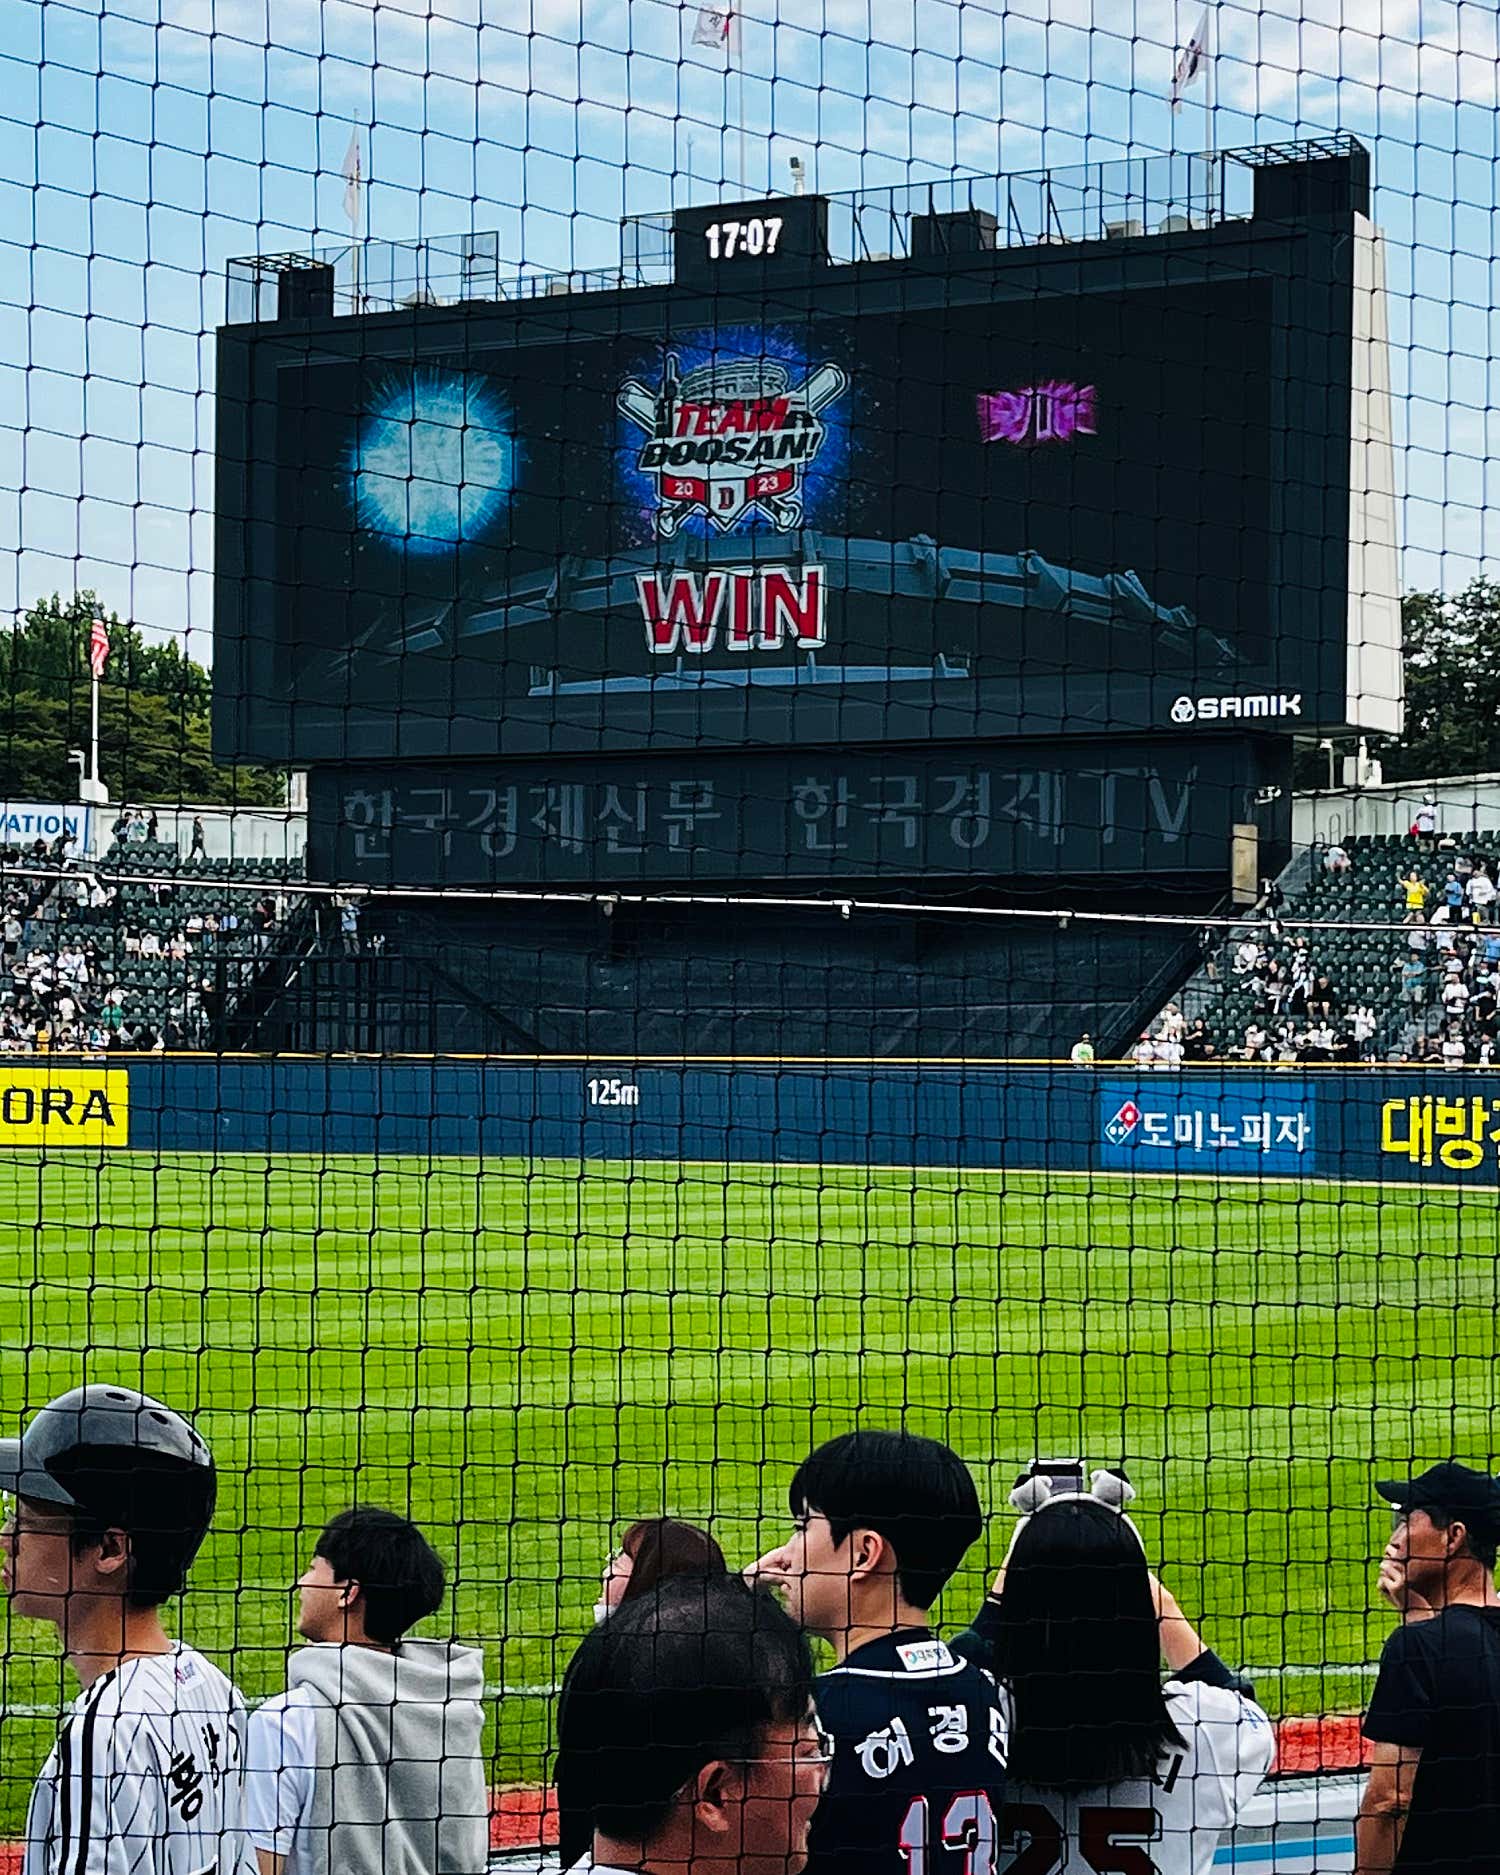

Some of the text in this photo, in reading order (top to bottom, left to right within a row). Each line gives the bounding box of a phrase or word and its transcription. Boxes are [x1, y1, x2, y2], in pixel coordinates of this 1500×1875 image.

[705, 218, 783, 259] 17:07
[675, 397, 790, 438] TEAM
[641, 431, 822, 468] DOOSAN!
[674, 476, 779, 510] 20 D 23
[635, 564, 828, 654] WIN
[1197, 694, 1302, 719] SAMIK
[587, 1079, 639, 1106] 125m
[1140, 1110, 1311, 1154] 도미노피자
[1381, 1094, 1500, 1170] 대방
